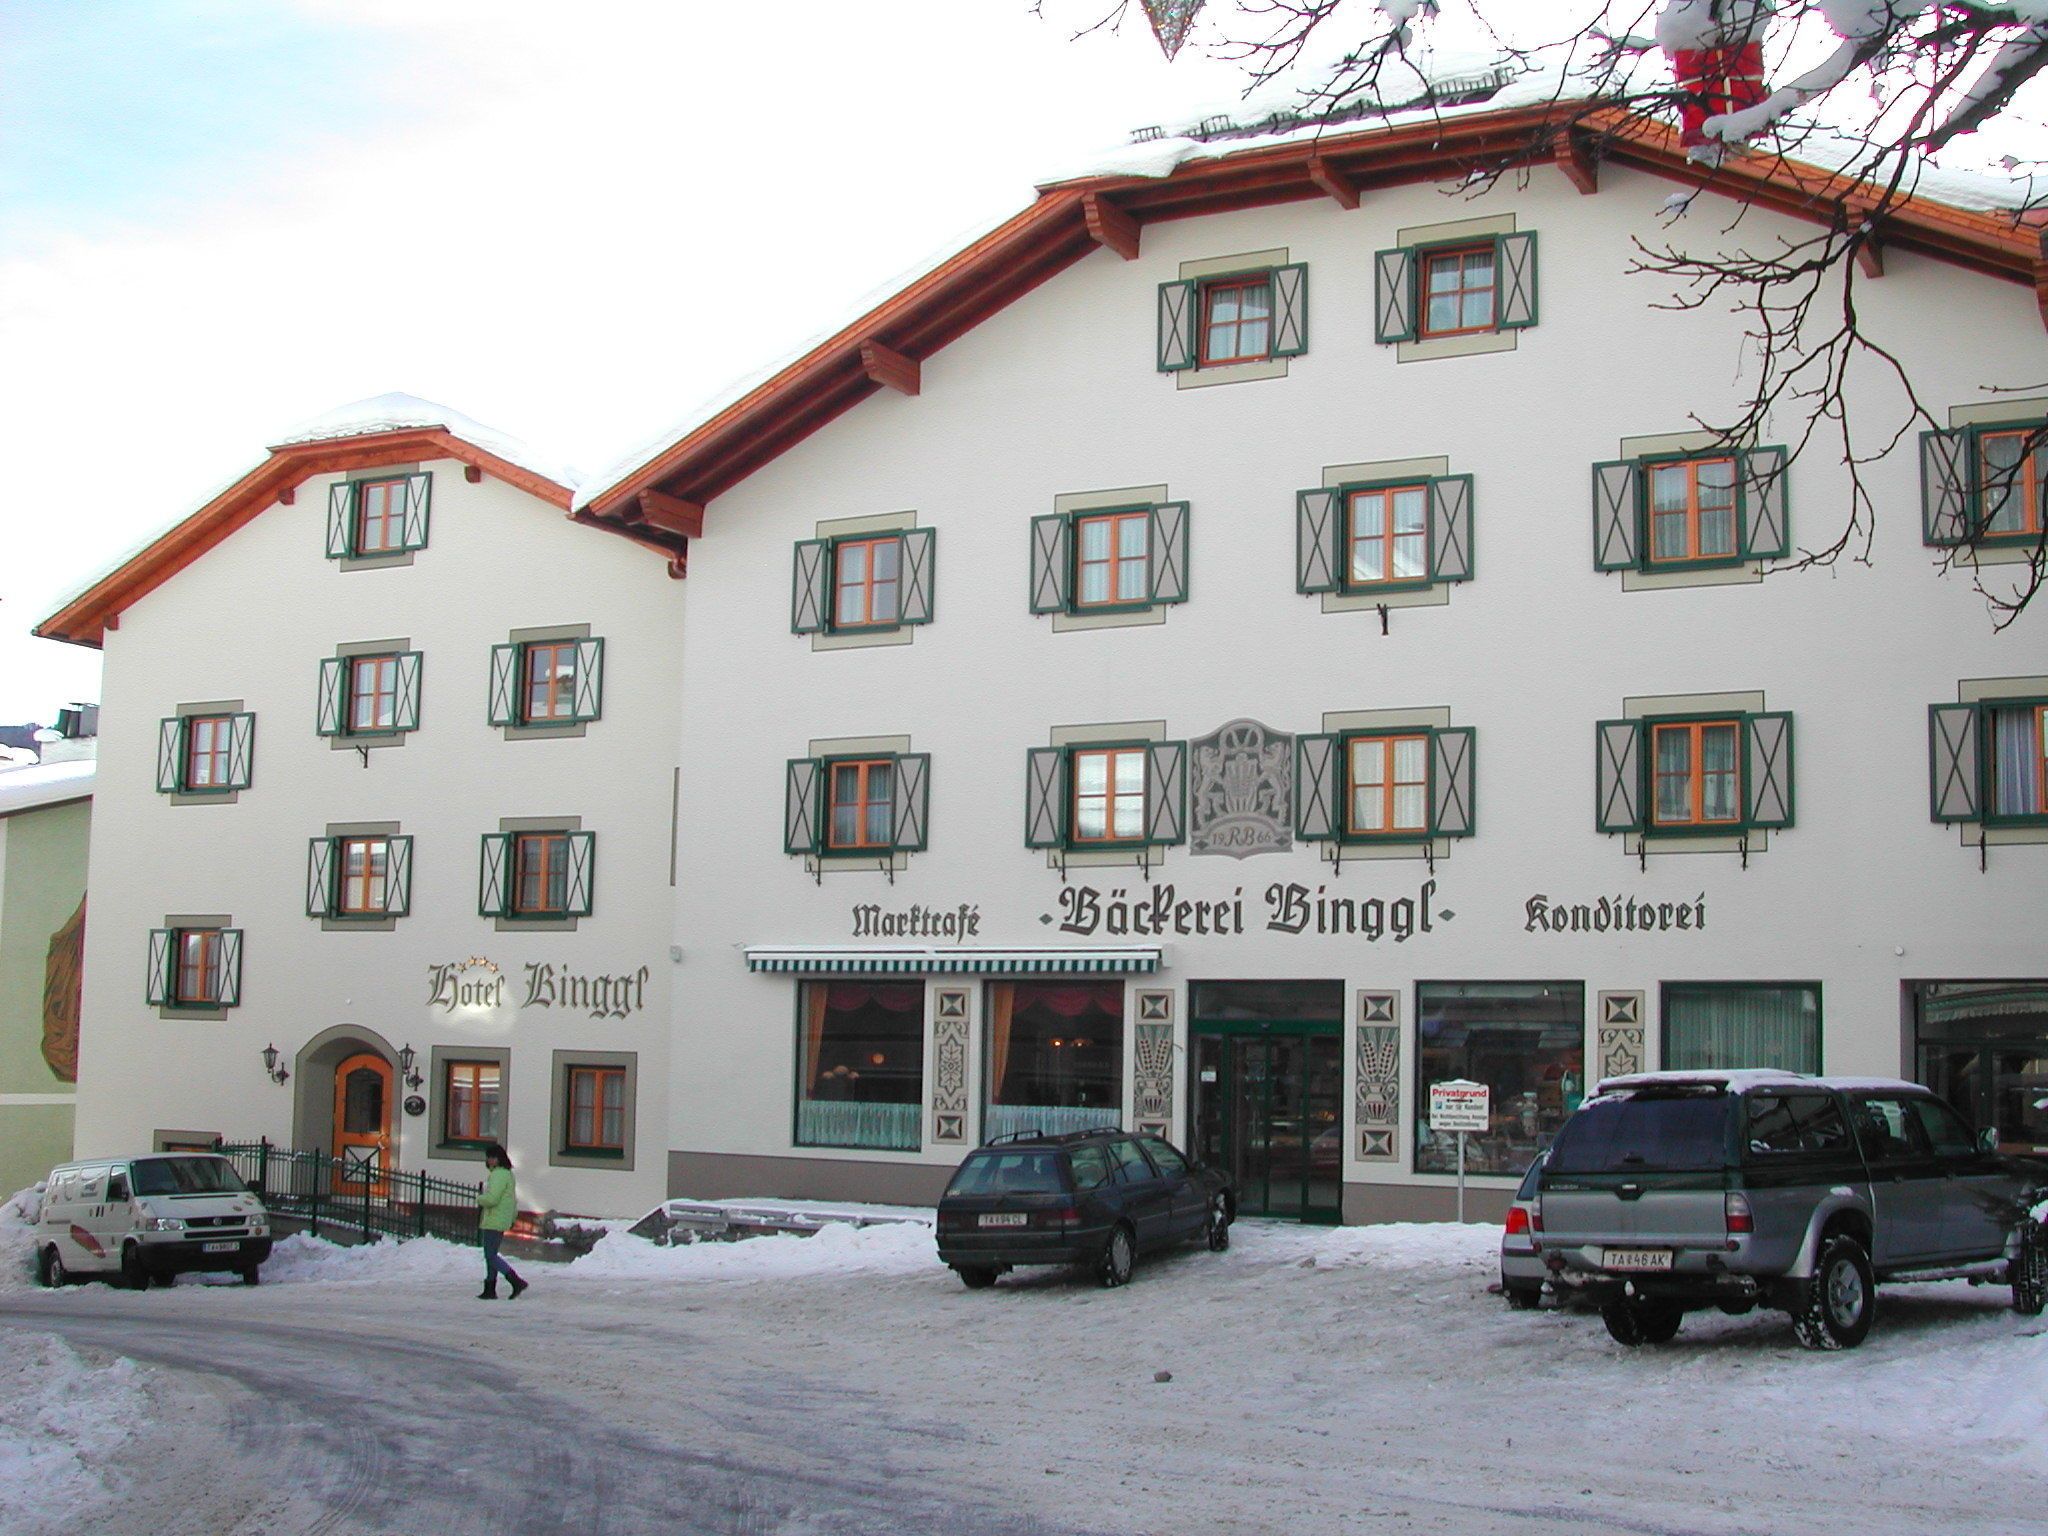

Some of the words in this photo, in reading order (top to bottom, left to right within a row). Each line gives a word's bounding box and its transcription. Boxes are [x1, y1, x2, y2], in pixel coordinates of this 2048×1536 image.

[1058, 883, 1245, 937] Bäckerei
[1264, 878, 1437, 944] Binggl
[1523, 890, 1707, 933] Konditorei
[425, 961, 506, 1014] Hotel
[520, 960, 649, 1020] Binggl
[1432, 1088, 1487, 1099] Privatgrund
